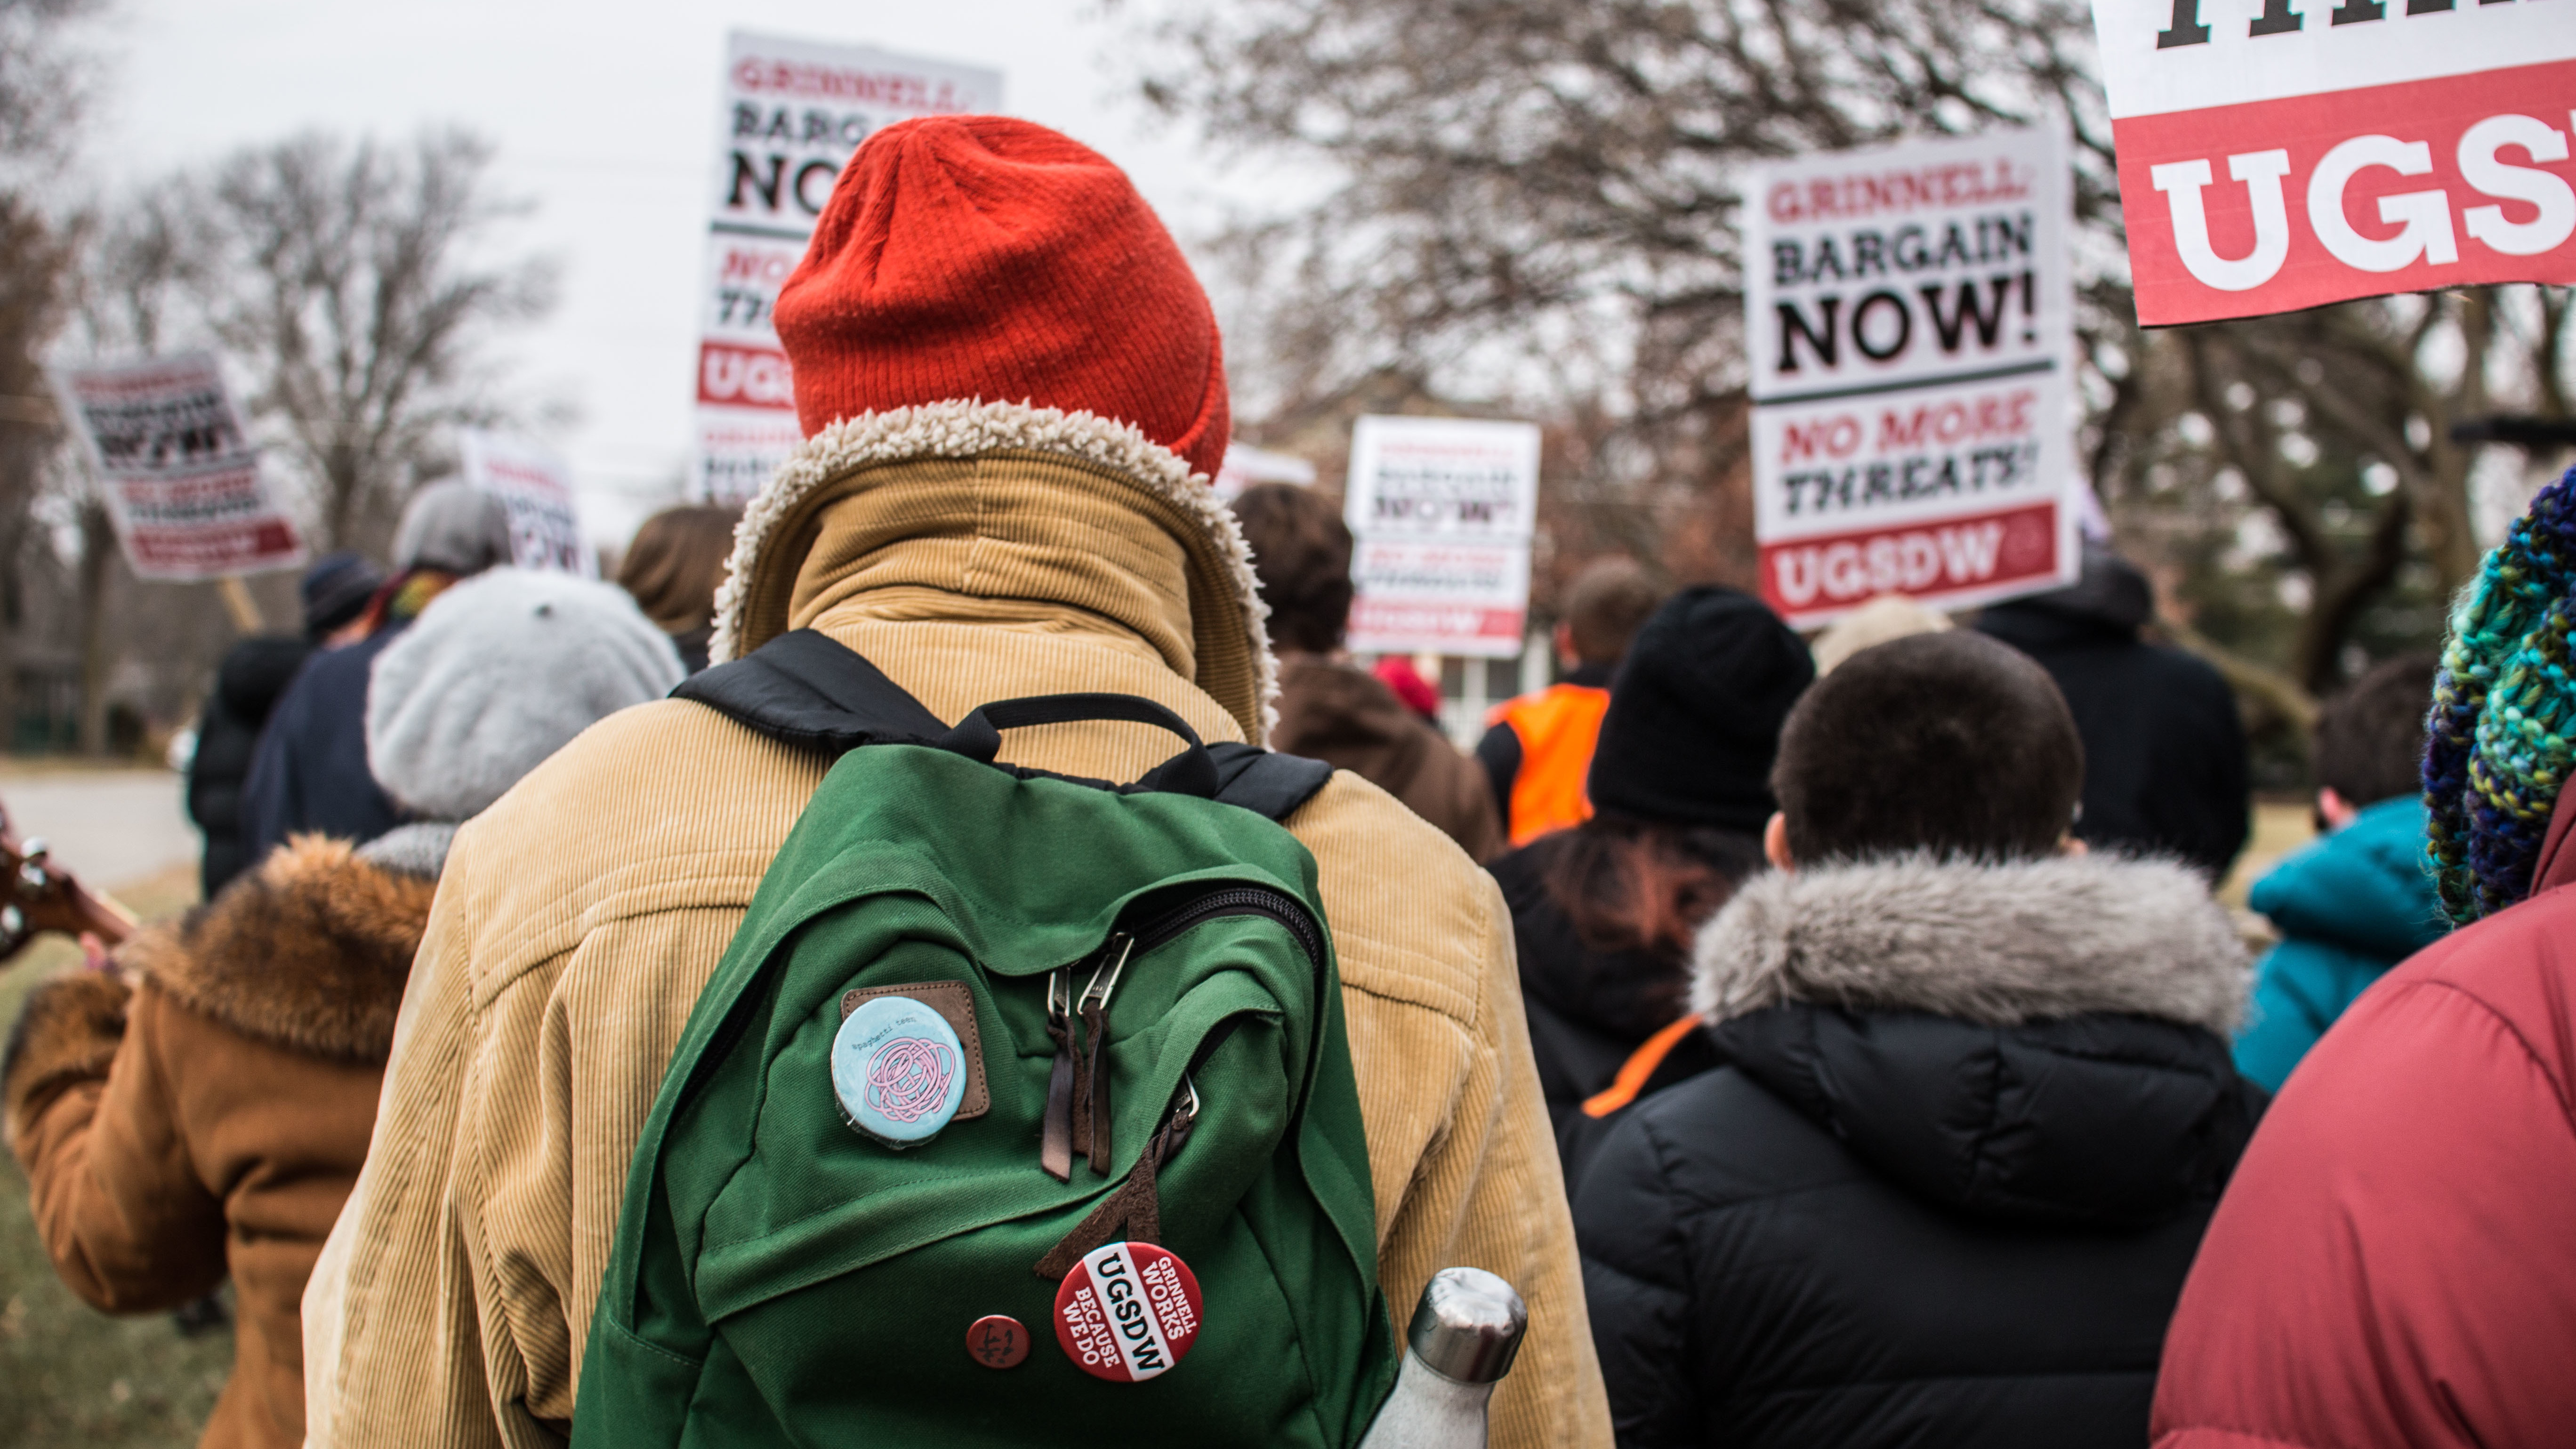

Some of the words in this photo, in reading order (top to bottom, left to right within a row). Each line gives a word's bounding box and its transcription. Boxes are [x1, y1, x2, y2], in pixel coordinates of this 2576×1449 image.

[733, 100, 871, 147] BARG
[728, 150, 840, 216] NO
[2150, 111, 2576, 292] UGS
[1772, 206, 2034, 288] BARGAIN
[1775, 271, 2035, 372] NOW!
[1780, 412, 1862, 464] NO
[1876, 388, 2037, 453] MORE
[1781, 438, 2039, 515] THREATS!
[1773, 520, 2004, 606] UGSDW
[896, 1017, 916, 1025] teen
[1063, 1301, 1089, 1338] WE
[1076, 1336, 1100, 1365] DO
[1075, 1287, 1120, 1368] BECAUSE
[1097, 1252, 1165, 1370] UGSDW
[1142, 1261, 1184, 1340] WORKS
[1159, 1256, 1197, 1334] GRINNELL
